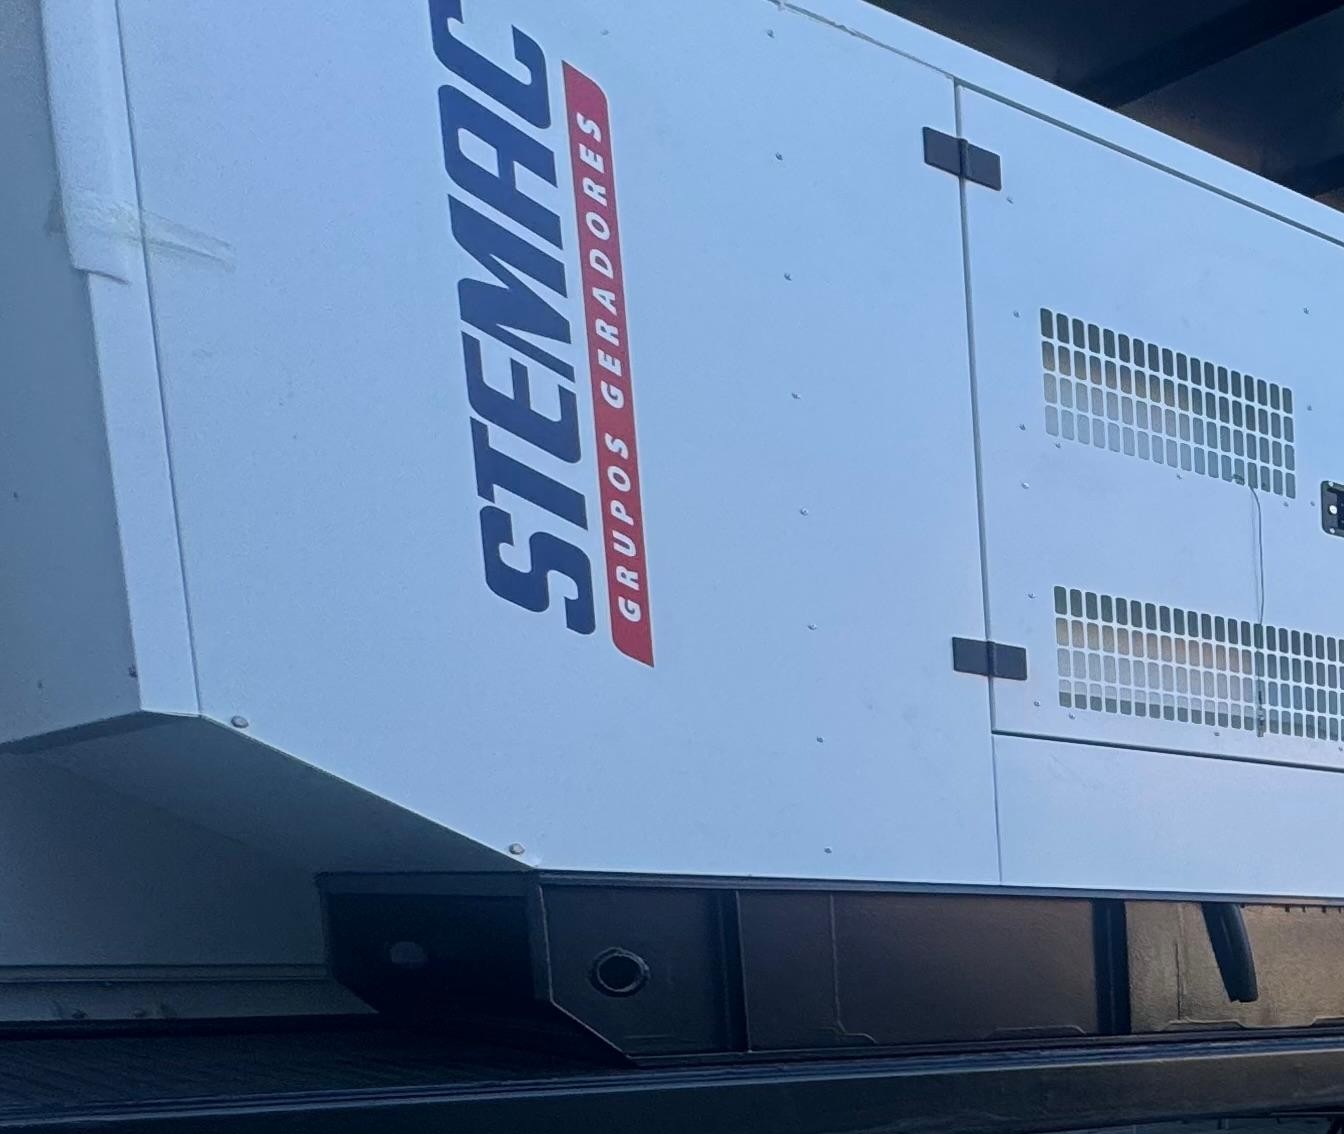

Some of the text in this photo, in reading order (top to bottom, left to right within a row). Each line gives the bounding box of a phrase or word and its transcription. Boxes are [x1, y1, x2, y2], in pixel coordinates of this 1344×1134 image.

[428, 0, 596, 635] STEMAC
[577, 112, 642, 622] GRUPOS GERADORES
